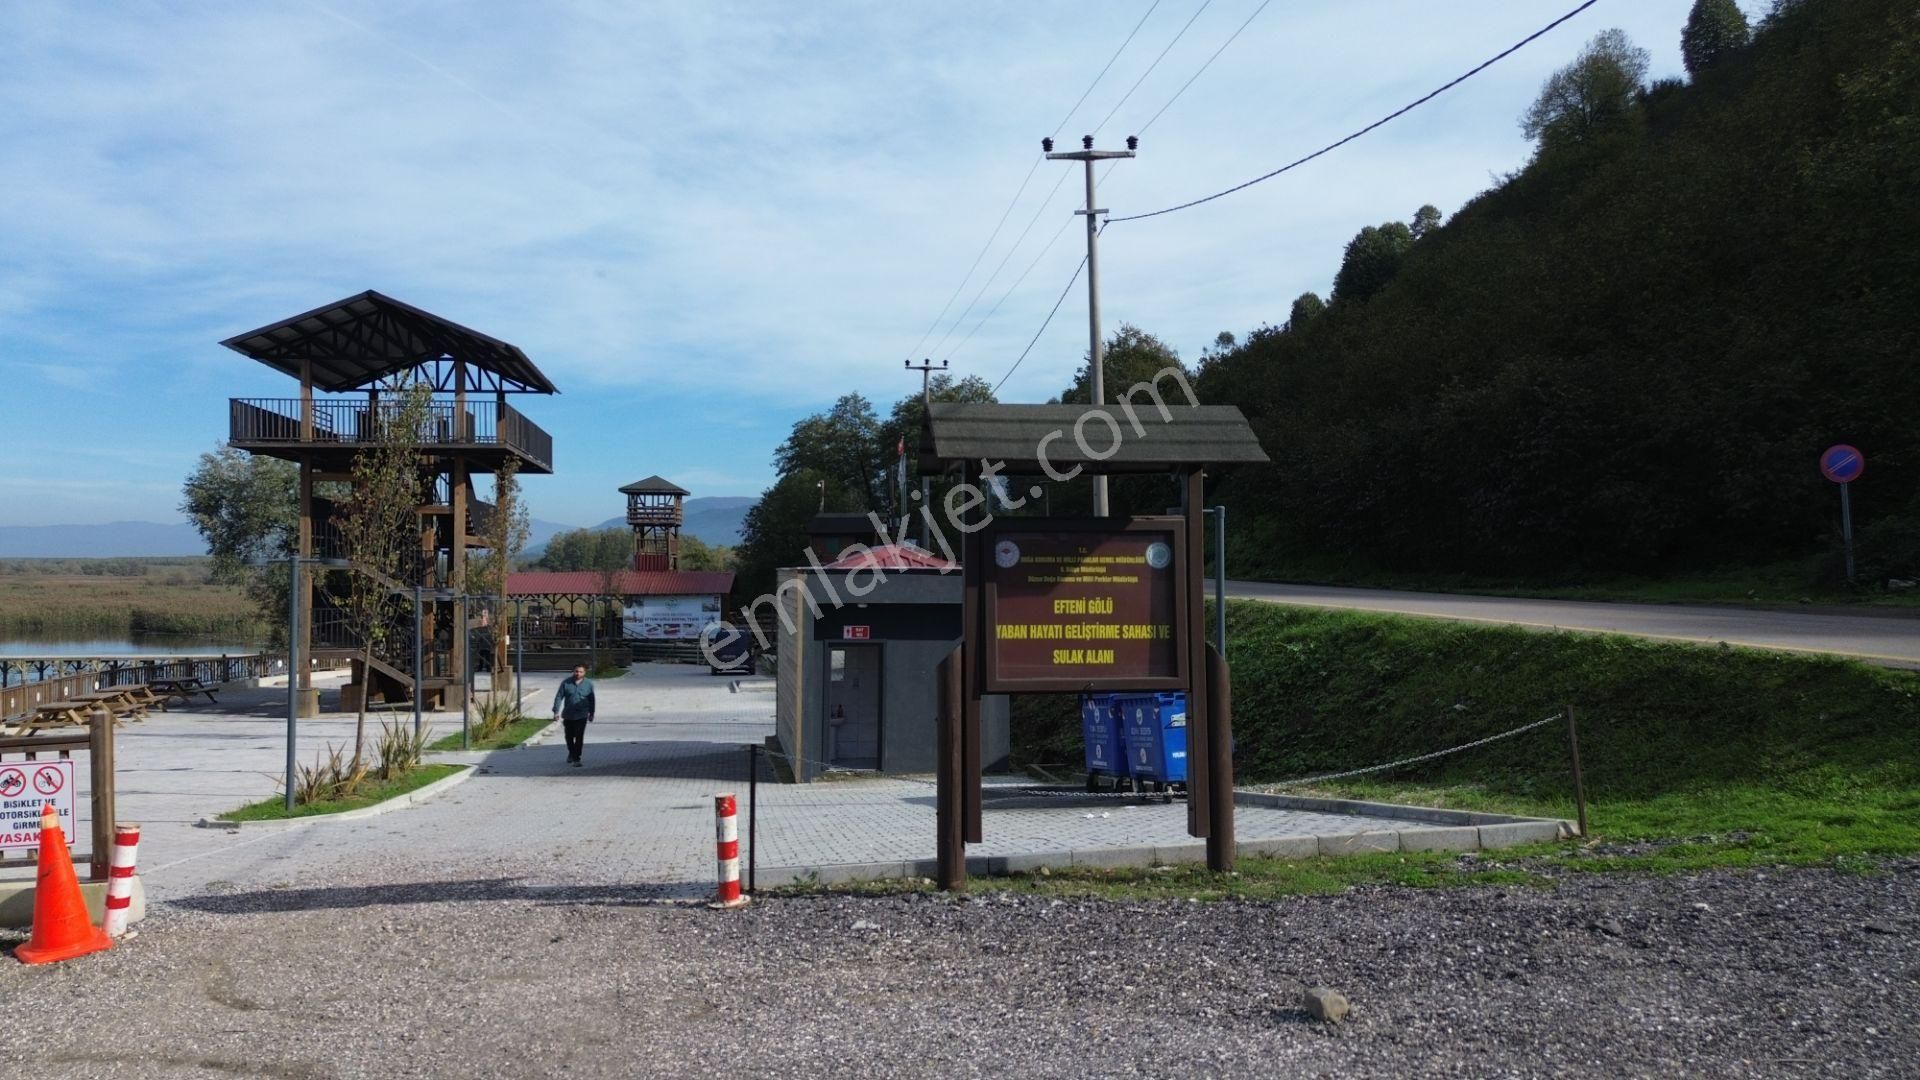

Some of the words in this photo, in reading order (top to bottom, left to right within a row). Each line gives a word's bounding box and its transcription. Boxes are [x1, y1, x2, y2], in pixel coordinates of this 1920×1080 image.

[1054, 597, 1086, 615] EFTENİ
[1088, 597, 1113, 615] GÖLÜ
[996, 624, 1027, 639] YABAN
[1029, 624, 1062, 639] HAYATI
[1065, 622, 1120, 641] GELİŞTİRME
[1122, 624, 1156, 639] SAHASI
[1158, 624, 1171, 639] VE
[1053, 649, 1084, 664] SULAK
[1086, 649, 1114, 664] ALANI
